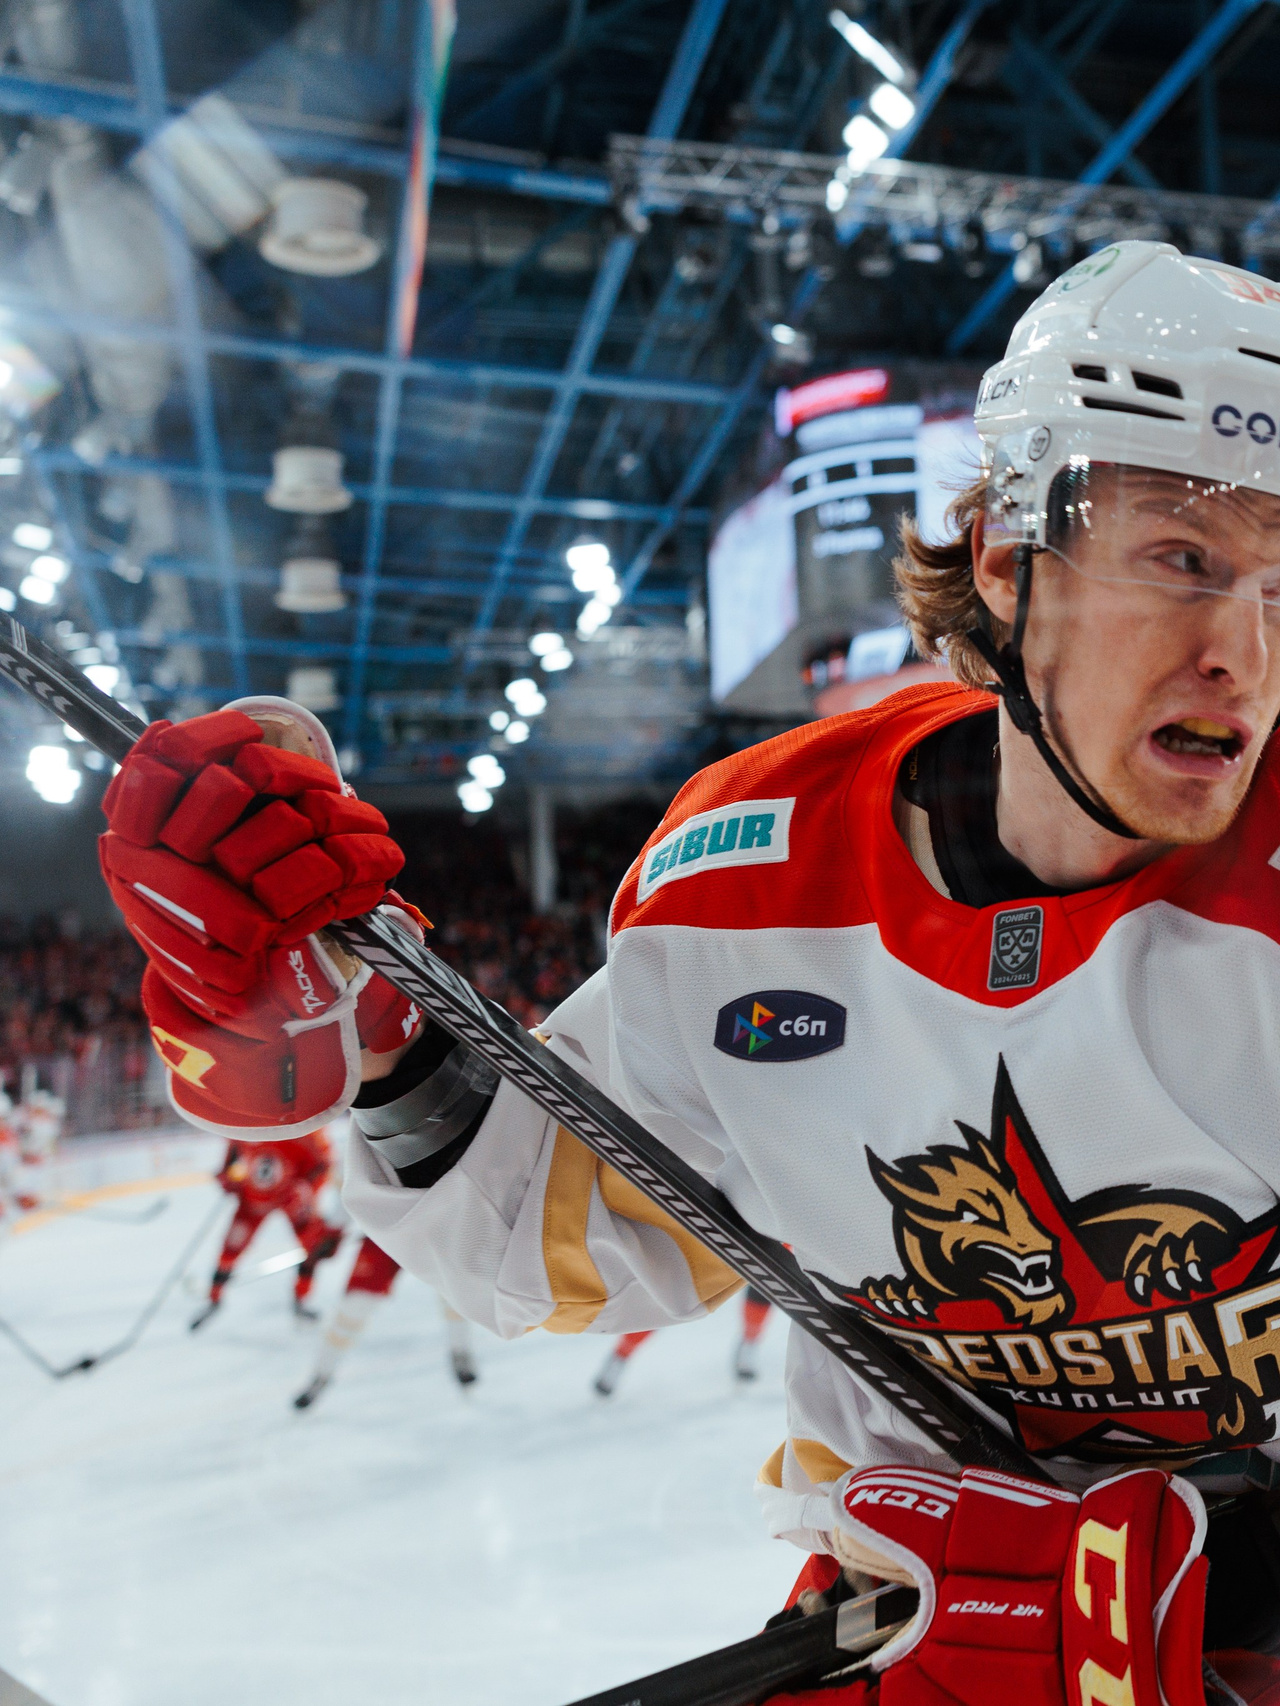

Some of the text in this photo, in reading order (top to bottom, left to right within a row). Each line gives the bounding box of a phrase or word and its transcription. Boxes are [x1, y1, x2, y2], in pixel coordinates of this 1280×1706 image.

[646, 812, 776, 885] SIBUR
[1000, 911, 1036, 925] FONBET
[288, 949, 327, 1014] TACKS
[993, 973, 1031, 985] 2024/2025
[778, 1014, 827, 1037] сбп
[990, 1386, 1211, 1408] KUNLUN
[849, 1488, 951, 1520] CCM
